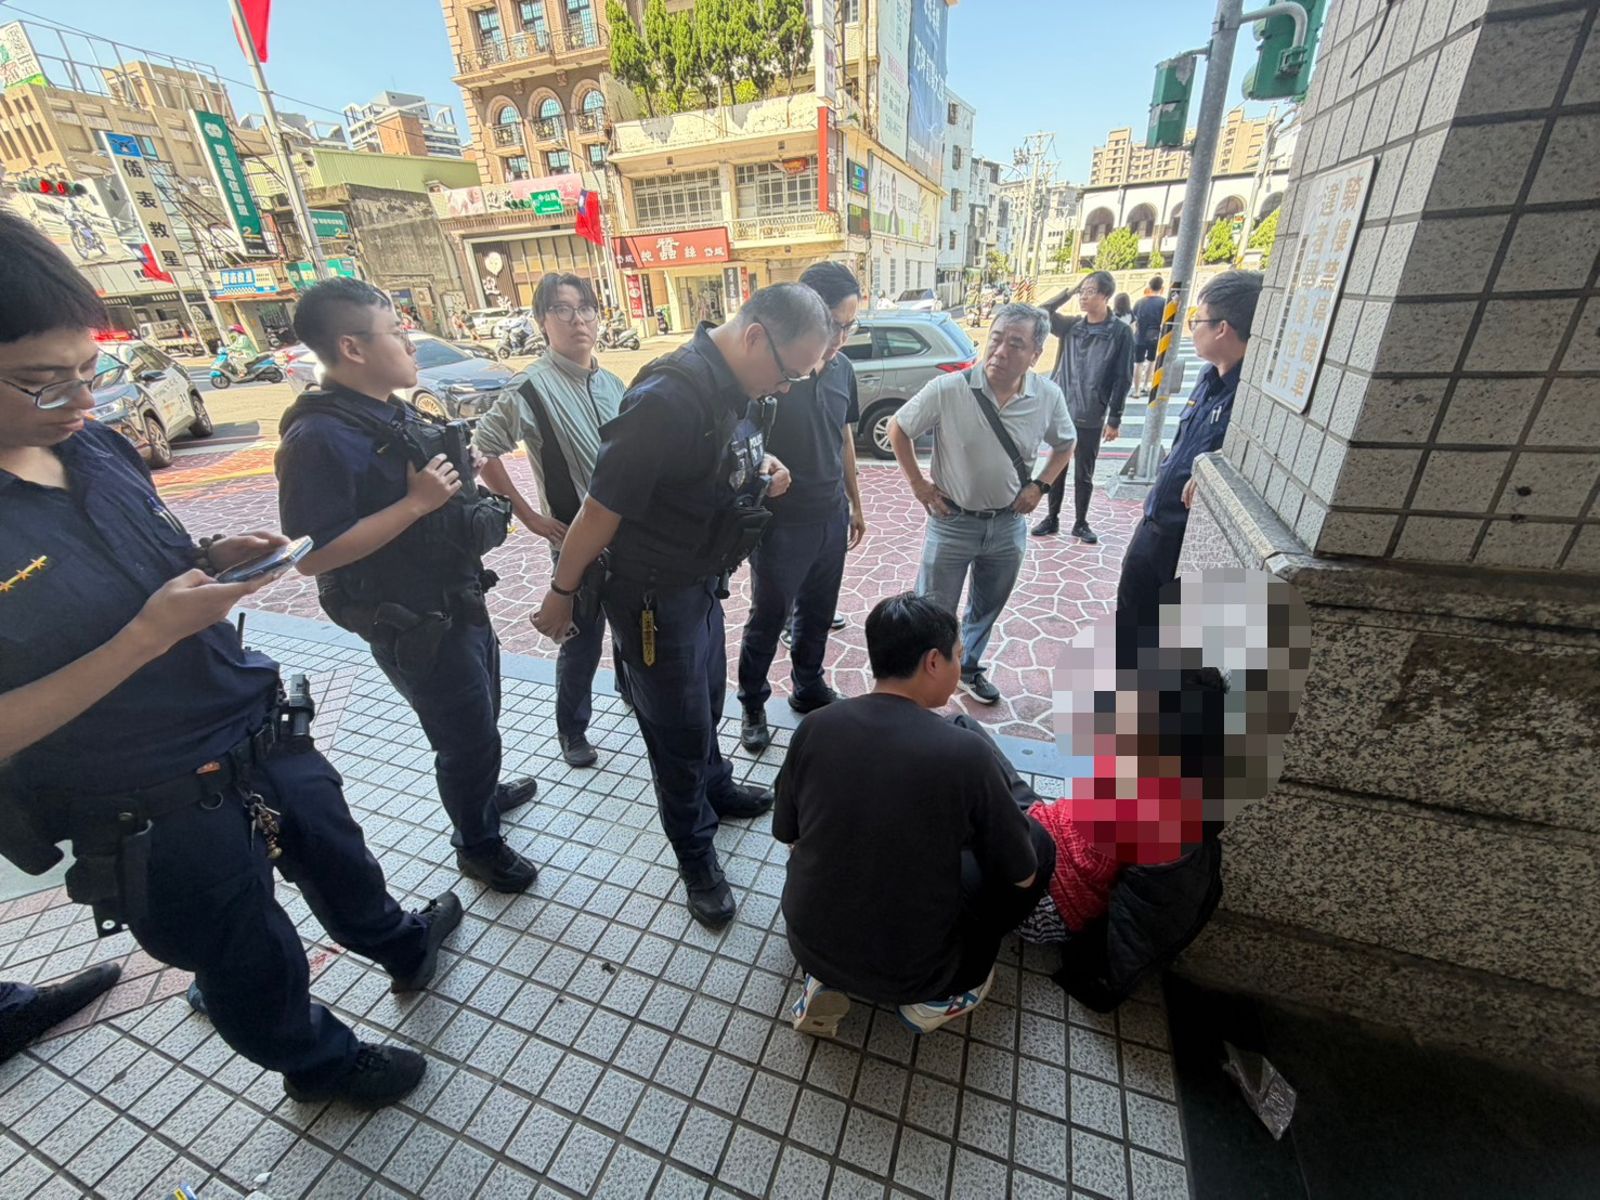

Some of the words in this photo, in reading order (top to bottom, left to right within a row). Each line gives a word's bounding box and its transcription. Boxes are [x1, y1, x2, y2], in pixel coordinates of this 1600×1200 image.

[122, 158, 182, 267] 儀表救星
[1290, 175, 1364, 397] 騎樓禁停機車
